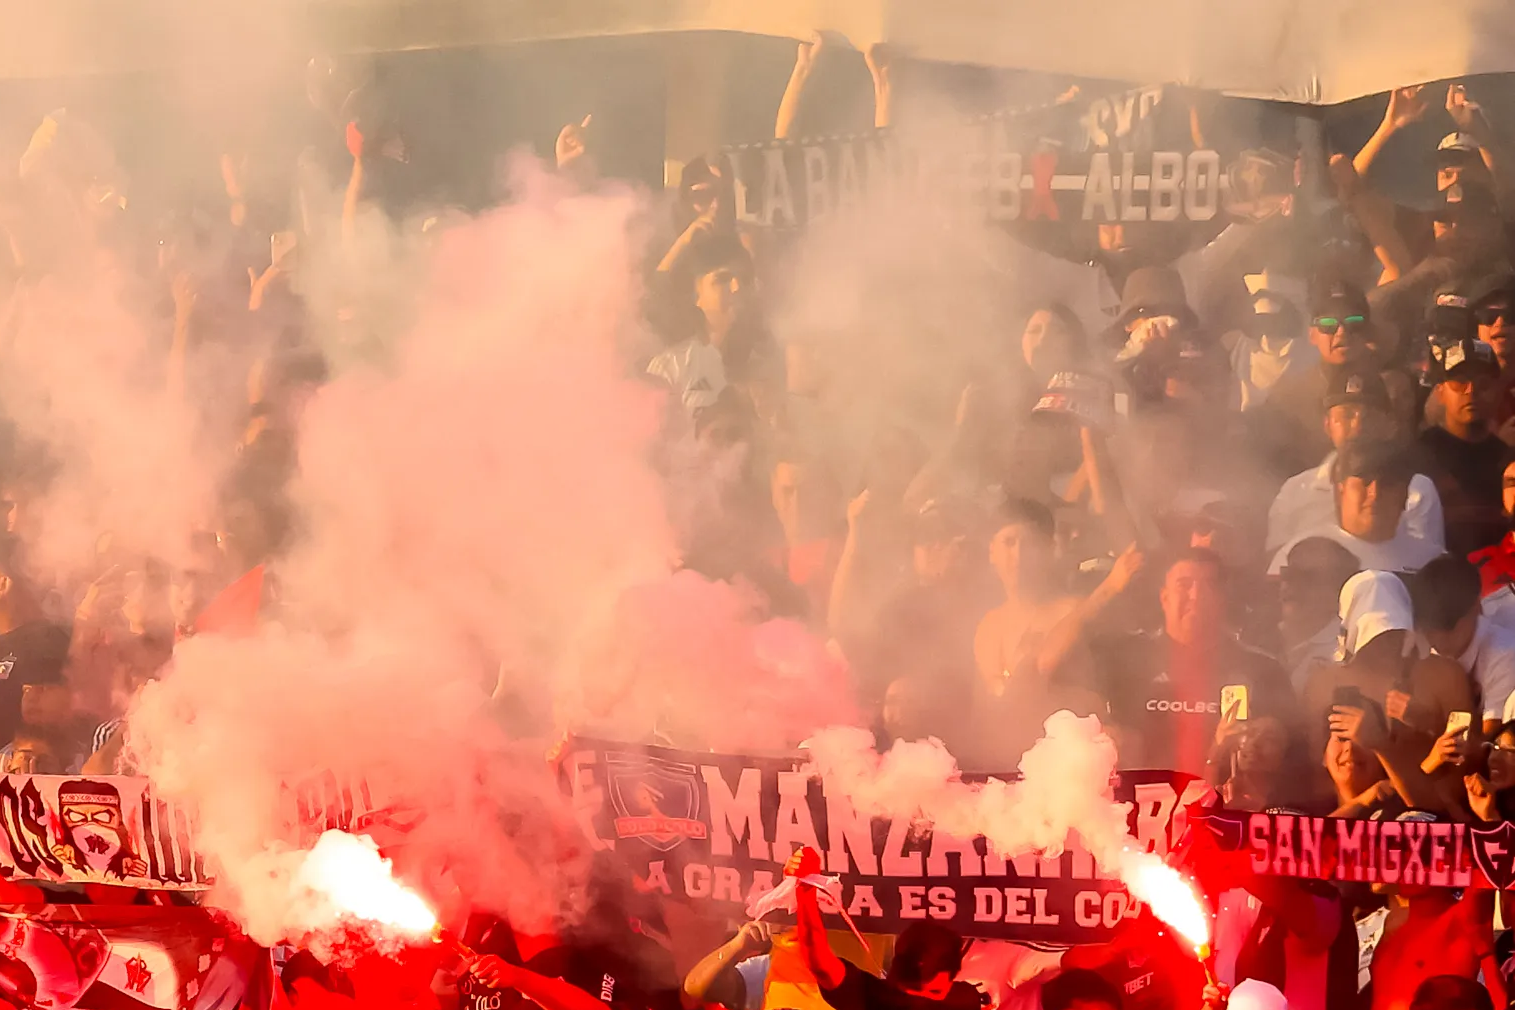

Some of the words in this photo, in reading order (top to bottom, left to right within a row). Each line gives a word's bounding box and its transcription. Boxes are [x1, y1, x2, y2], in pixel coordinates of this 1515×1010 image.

[1081, 150, 1221, 222] ALBO
[1145, 698, 1218, 713] COOLBE
[1249, 813, 1324, 877] SAN
[1335, 818, 1471, 887] MIGXEL
[645, 860, 673, 894] A
[898, 885, 957, 919] ES
[973, 887, 1060, 925] DEL
[1075, 890, 1140, 929] CO
